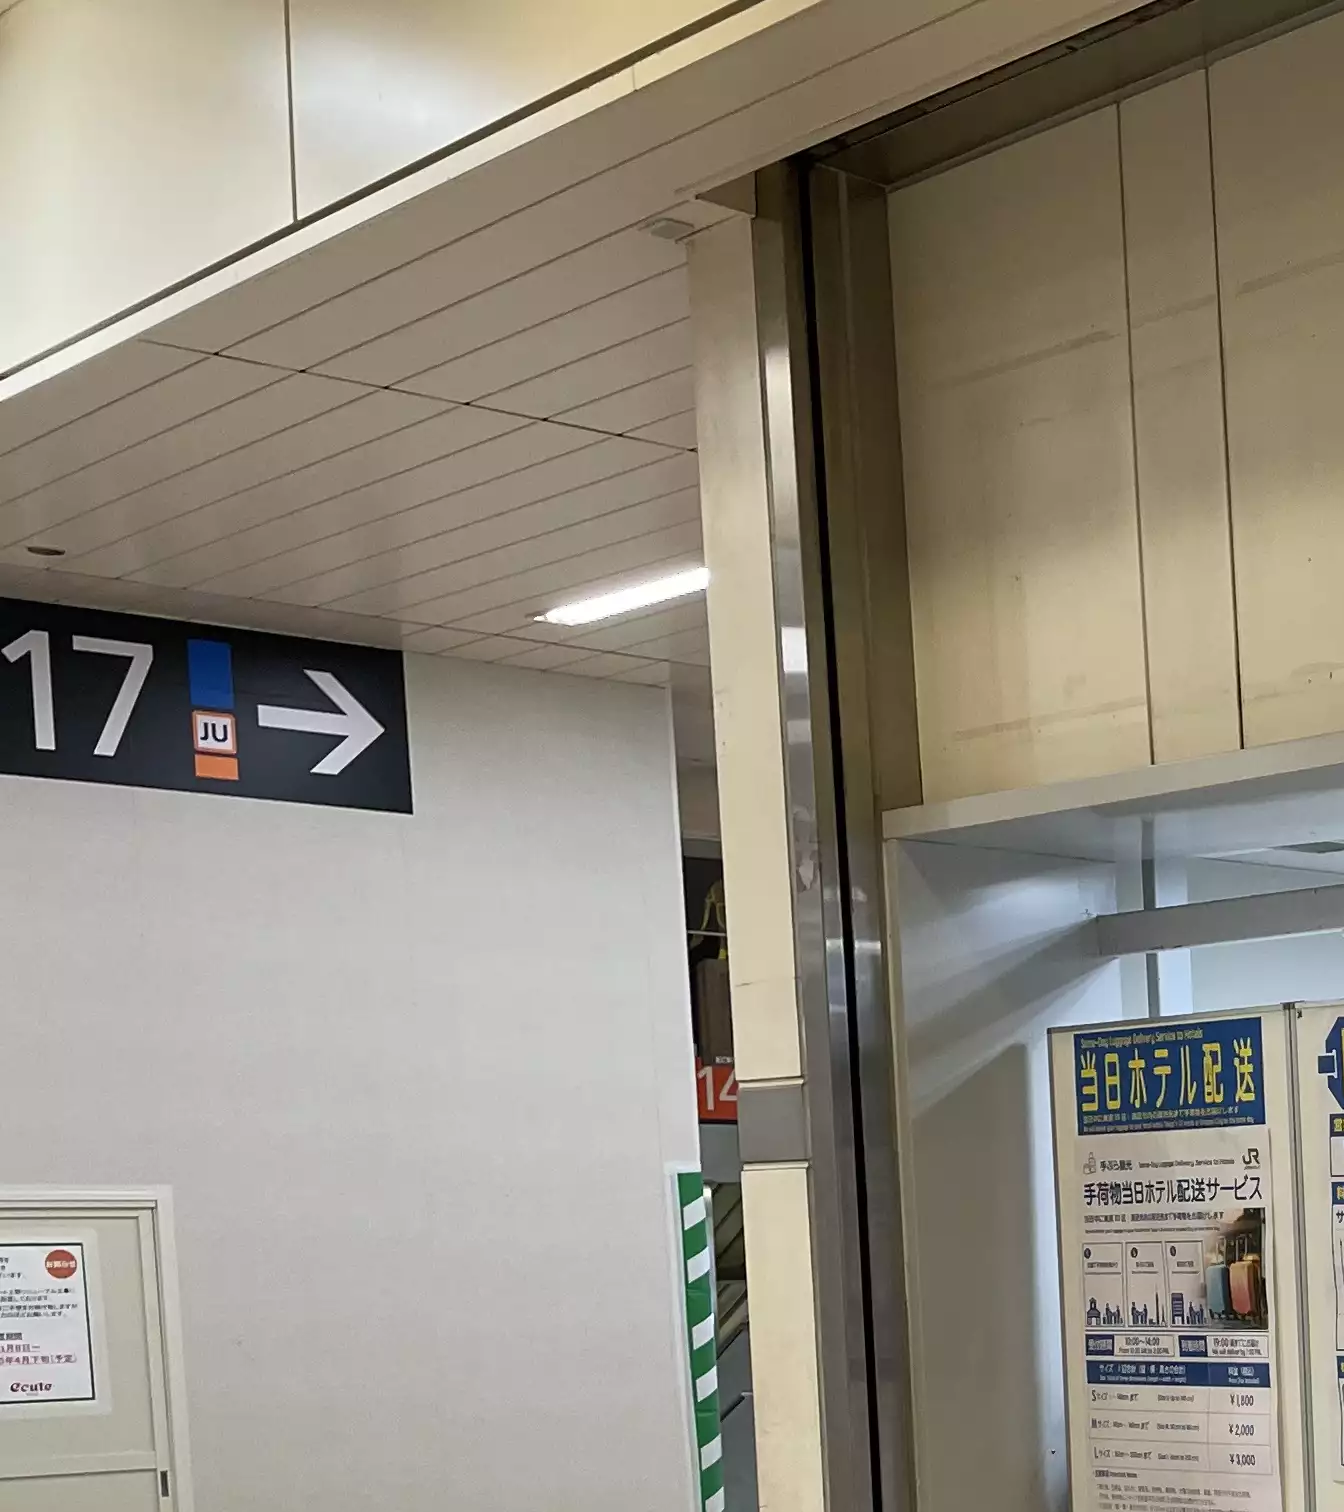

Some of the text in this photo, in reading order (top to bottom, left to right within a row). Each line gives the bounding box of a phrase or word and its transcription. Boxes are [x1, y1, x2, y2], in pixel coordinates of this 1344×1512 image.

[2, 630, 228, 757] 17 JU
[1080, 1037, 1256, 1111] 当日ホテル配送
[1242, 1148, 1260, 1164] JR
[1084, 1174, 1262, 1206] 手荷物当日ホテル配送サービス
